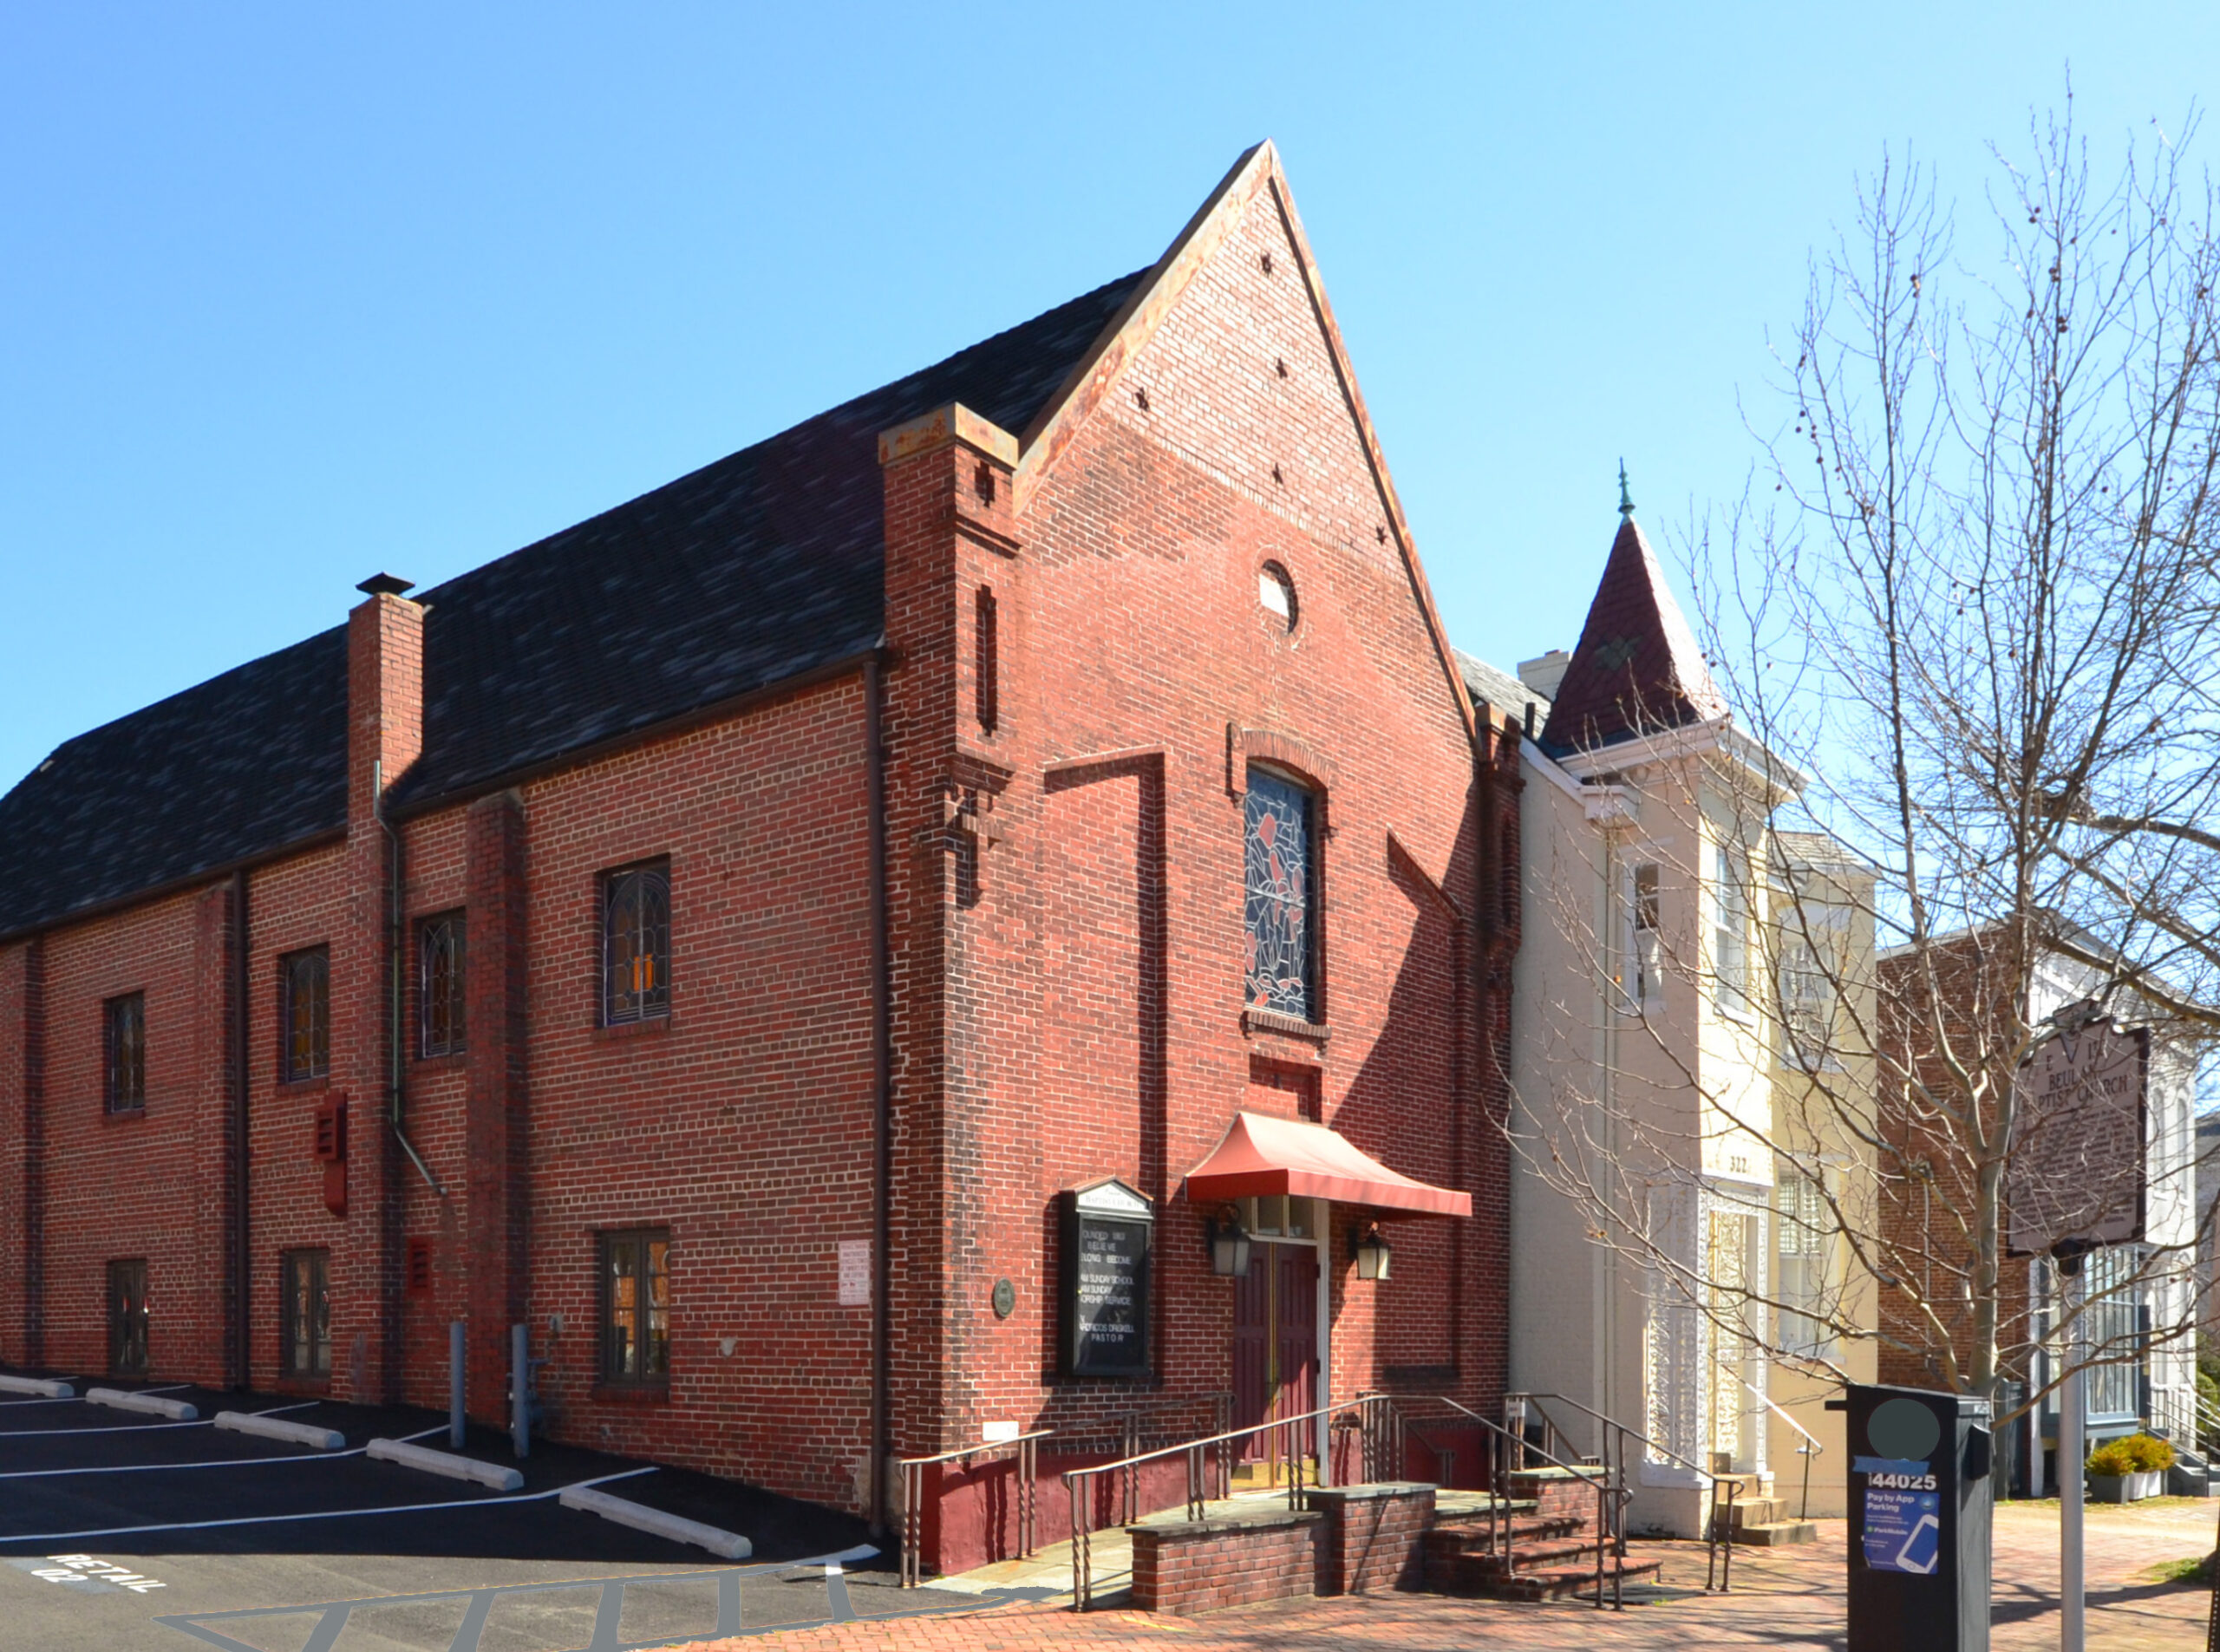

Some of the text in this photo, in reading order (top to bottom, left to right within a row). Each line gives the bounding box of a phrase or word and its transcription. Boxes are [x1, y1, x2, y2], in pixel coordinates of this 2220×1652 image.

[1730, 1156, 1747, 1172] 322
[1083, 1230, 1108, 1241] OUNDED
[1091, 1333, 1124, 1342] PASTOR
[1867, 1492, 1915, 1505] Pay by App
[1867, 1502, 1899, 1513] Parking
[30, 1568, 89, 1583] 02
[47, 1554, 166, 1594] RETAIL
